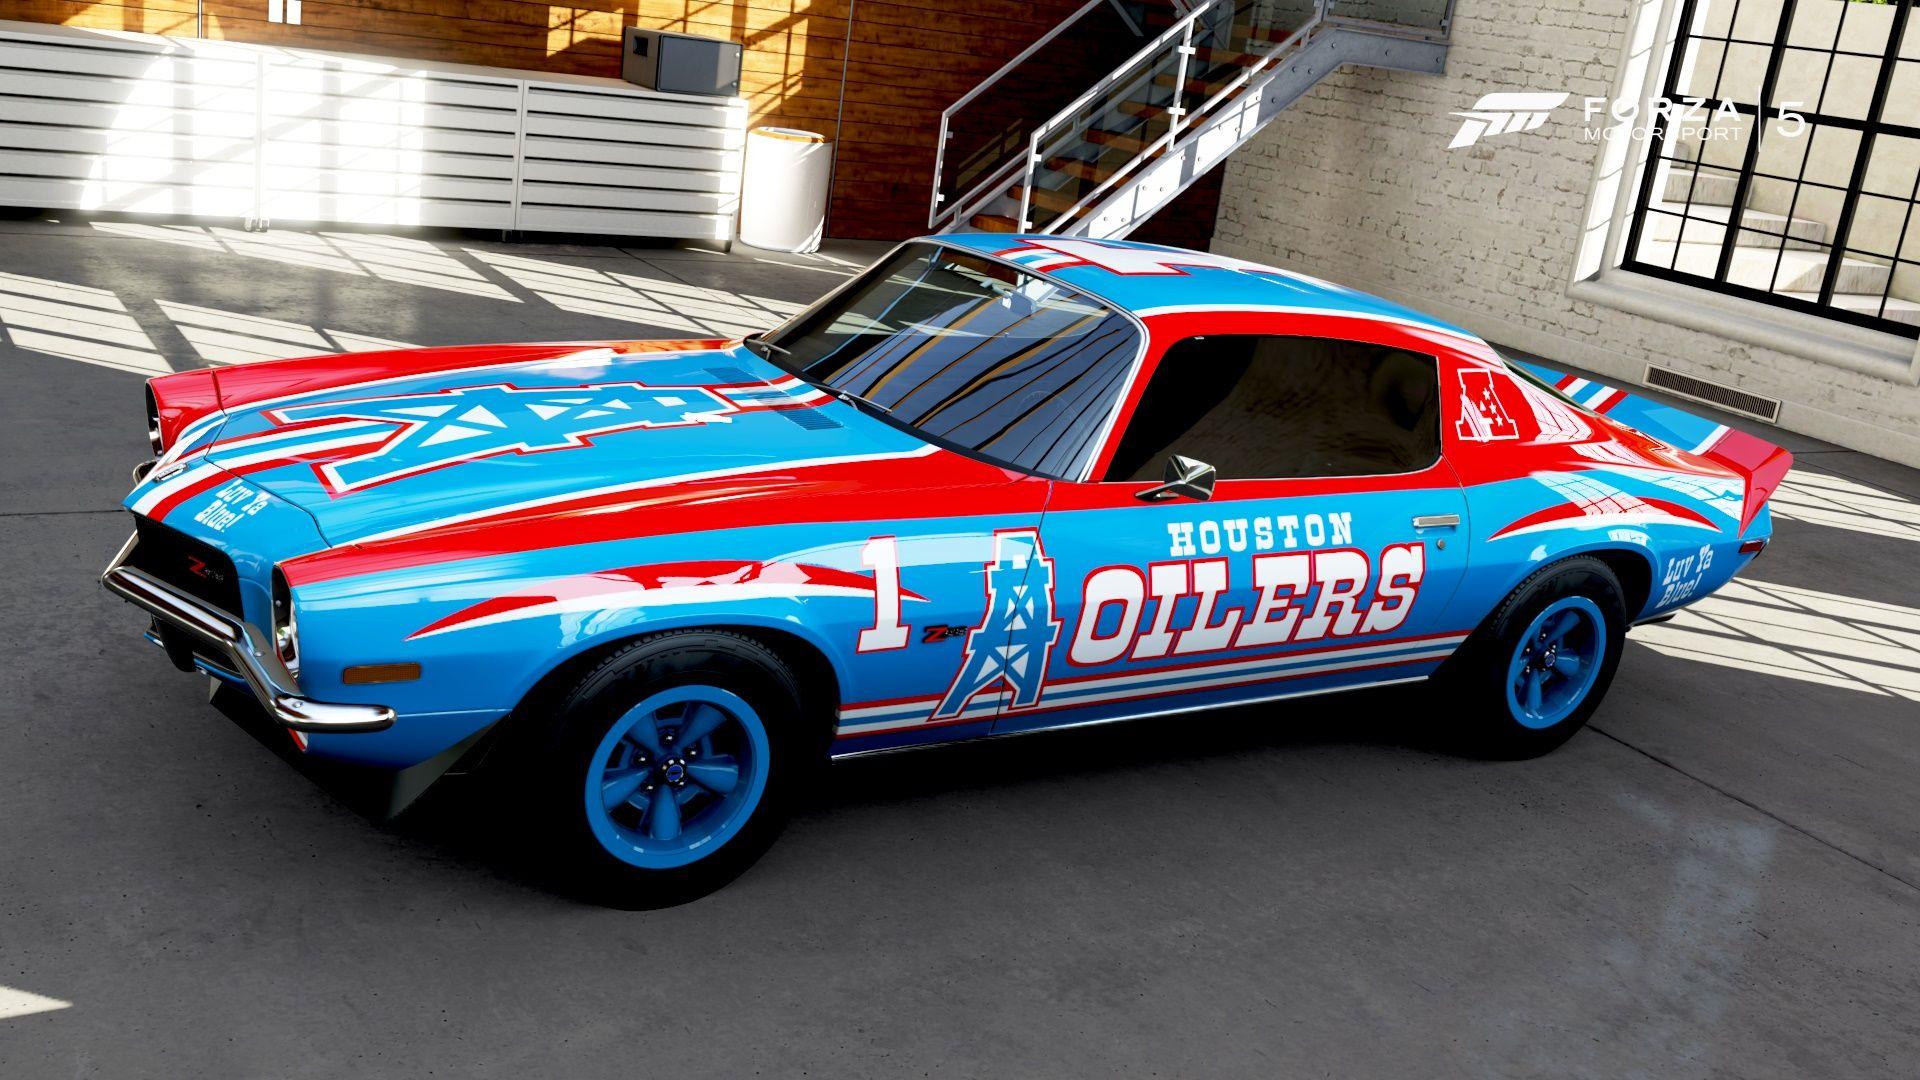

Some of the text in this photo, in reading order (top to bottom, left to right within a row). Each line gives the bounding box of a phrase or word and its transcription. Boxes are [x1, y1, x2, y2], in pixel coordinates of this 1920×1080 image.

[194, 500, 245, 533] Blue!
[1167, 512, 1352, 557] HOUSTON
[856, 535, 911, 654] 1
[1066, 541, 1425, 667] OILERS
[1654, 572, 1703, 609] Blue!
